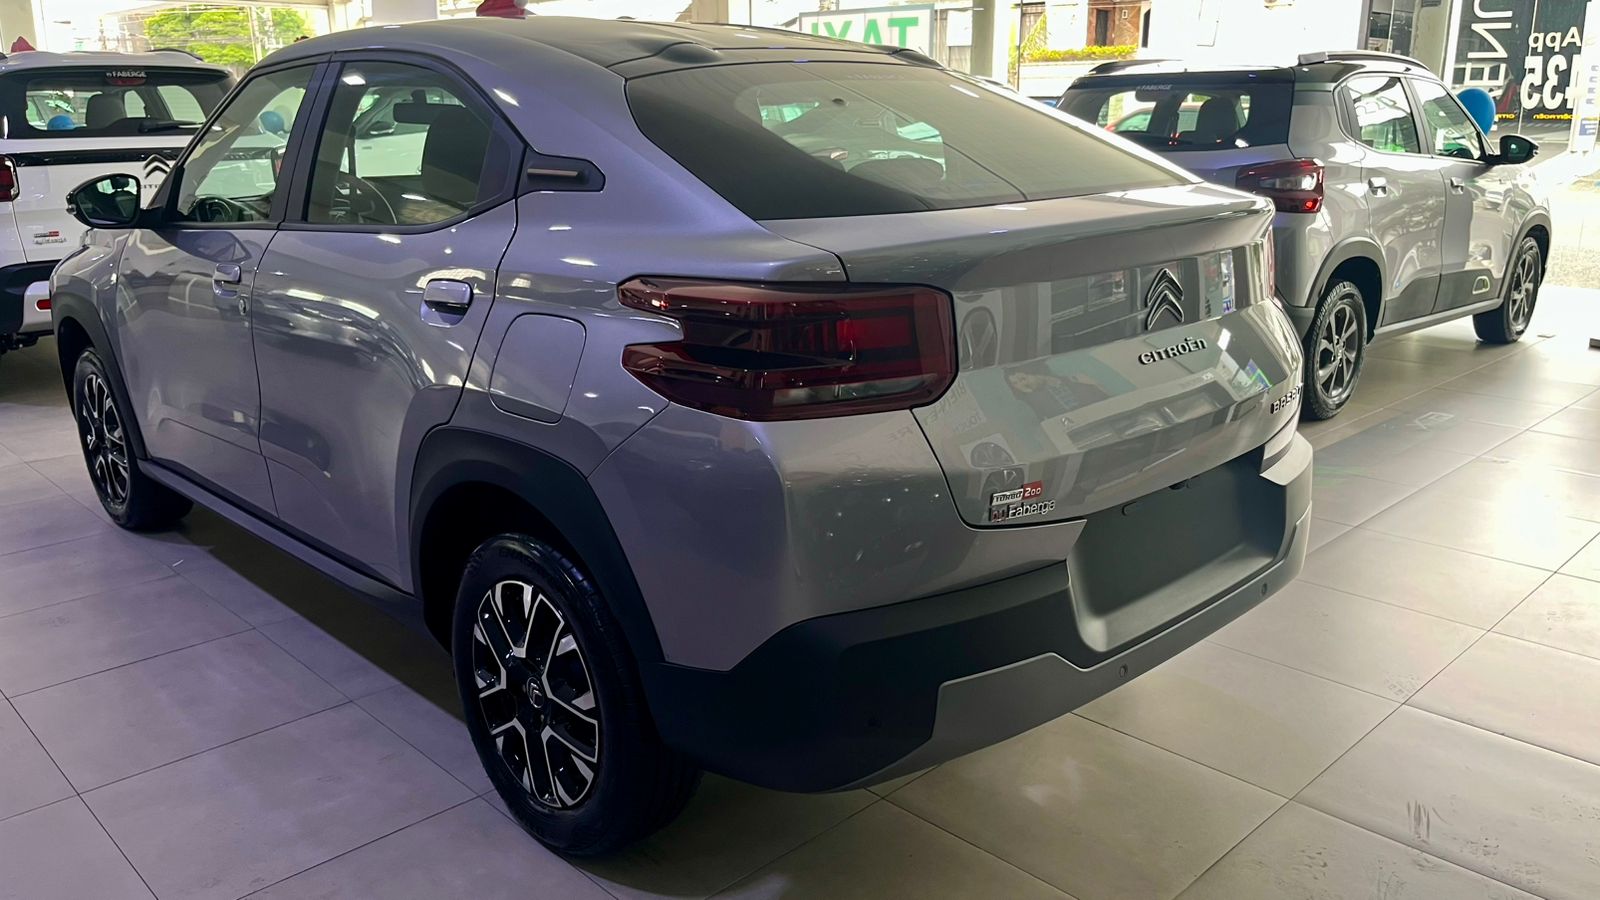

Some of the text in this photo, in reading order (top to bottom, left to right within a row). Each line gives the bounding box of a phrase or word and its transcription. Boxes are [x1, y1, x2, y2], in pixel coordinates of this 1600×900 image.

[994, 487, 1041, 502] TURBO 200
[1008, 500, 1056, 519] Faberge
